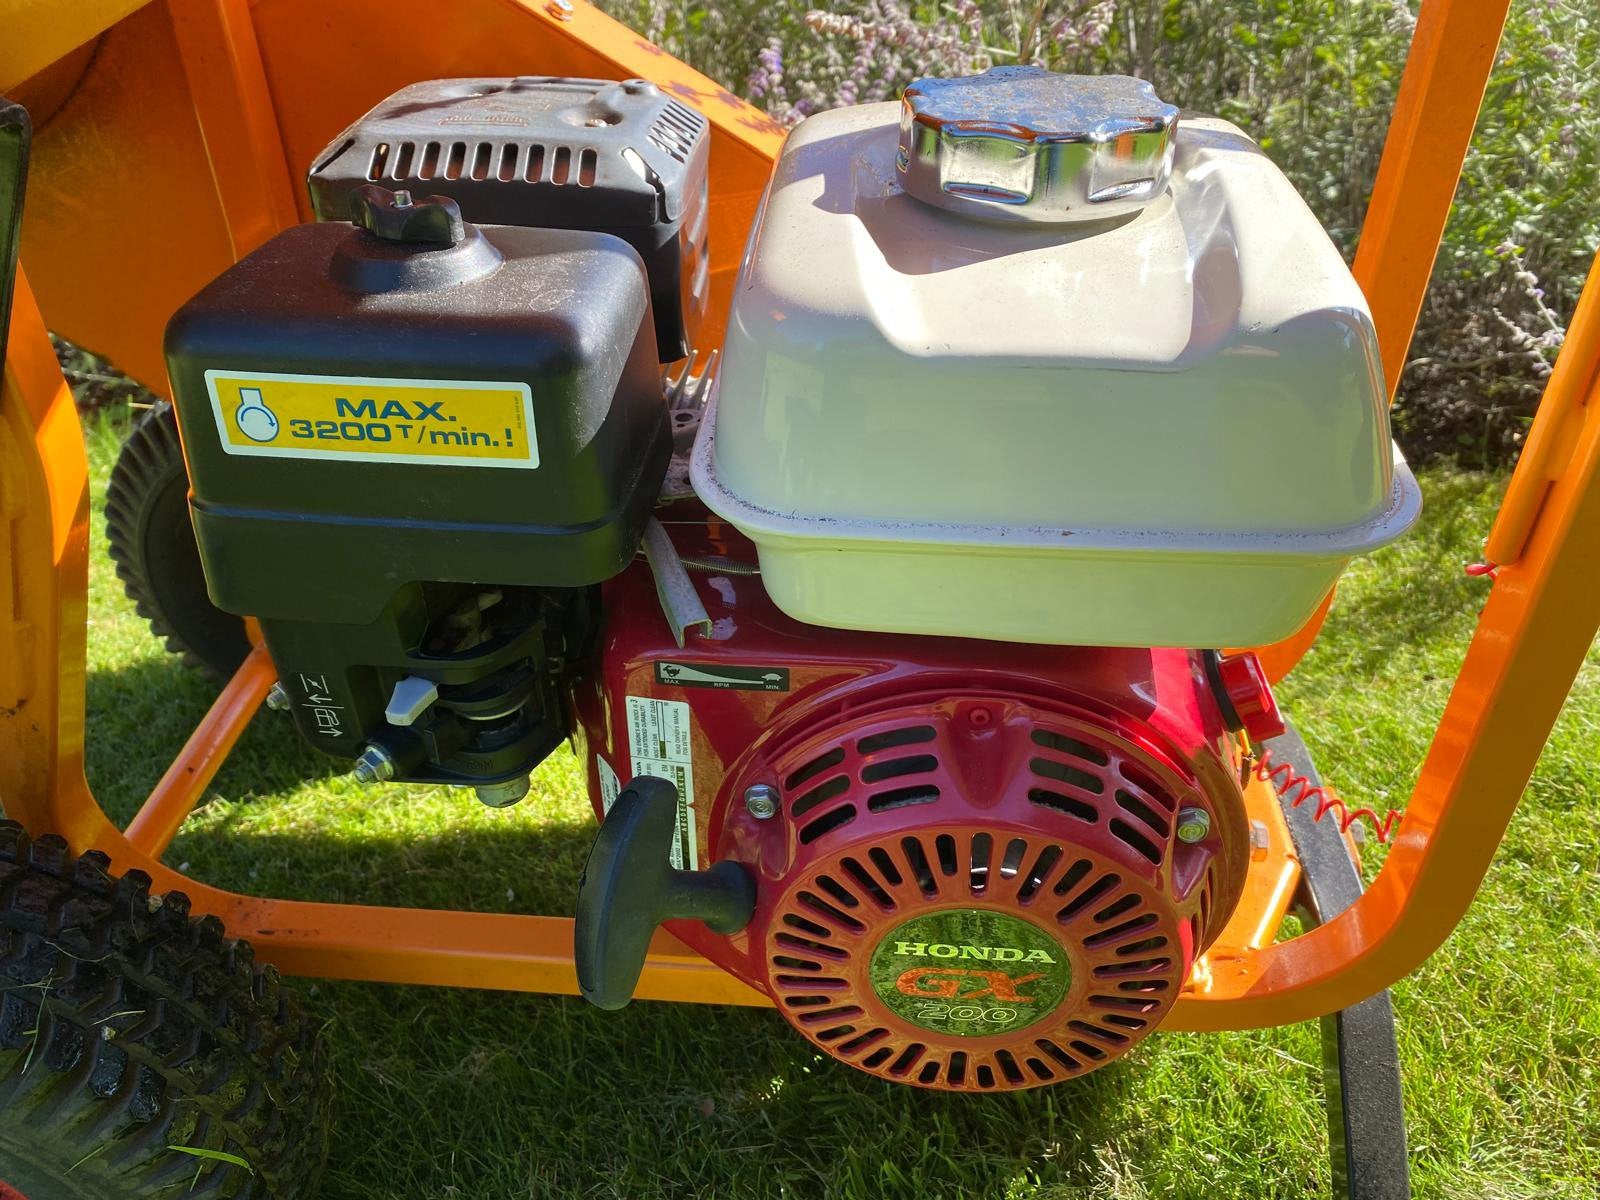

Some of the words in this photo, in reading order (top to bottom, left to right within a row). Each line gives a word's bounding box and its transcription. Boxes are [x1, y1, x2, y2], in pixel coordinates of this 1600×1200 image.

[335, 397, 457, 422] MAX.
[893, 941, 1057, 964] HONDA
[896, 967, 1048, 1003] GX
[917, 1003, 1017, 1023] 200
